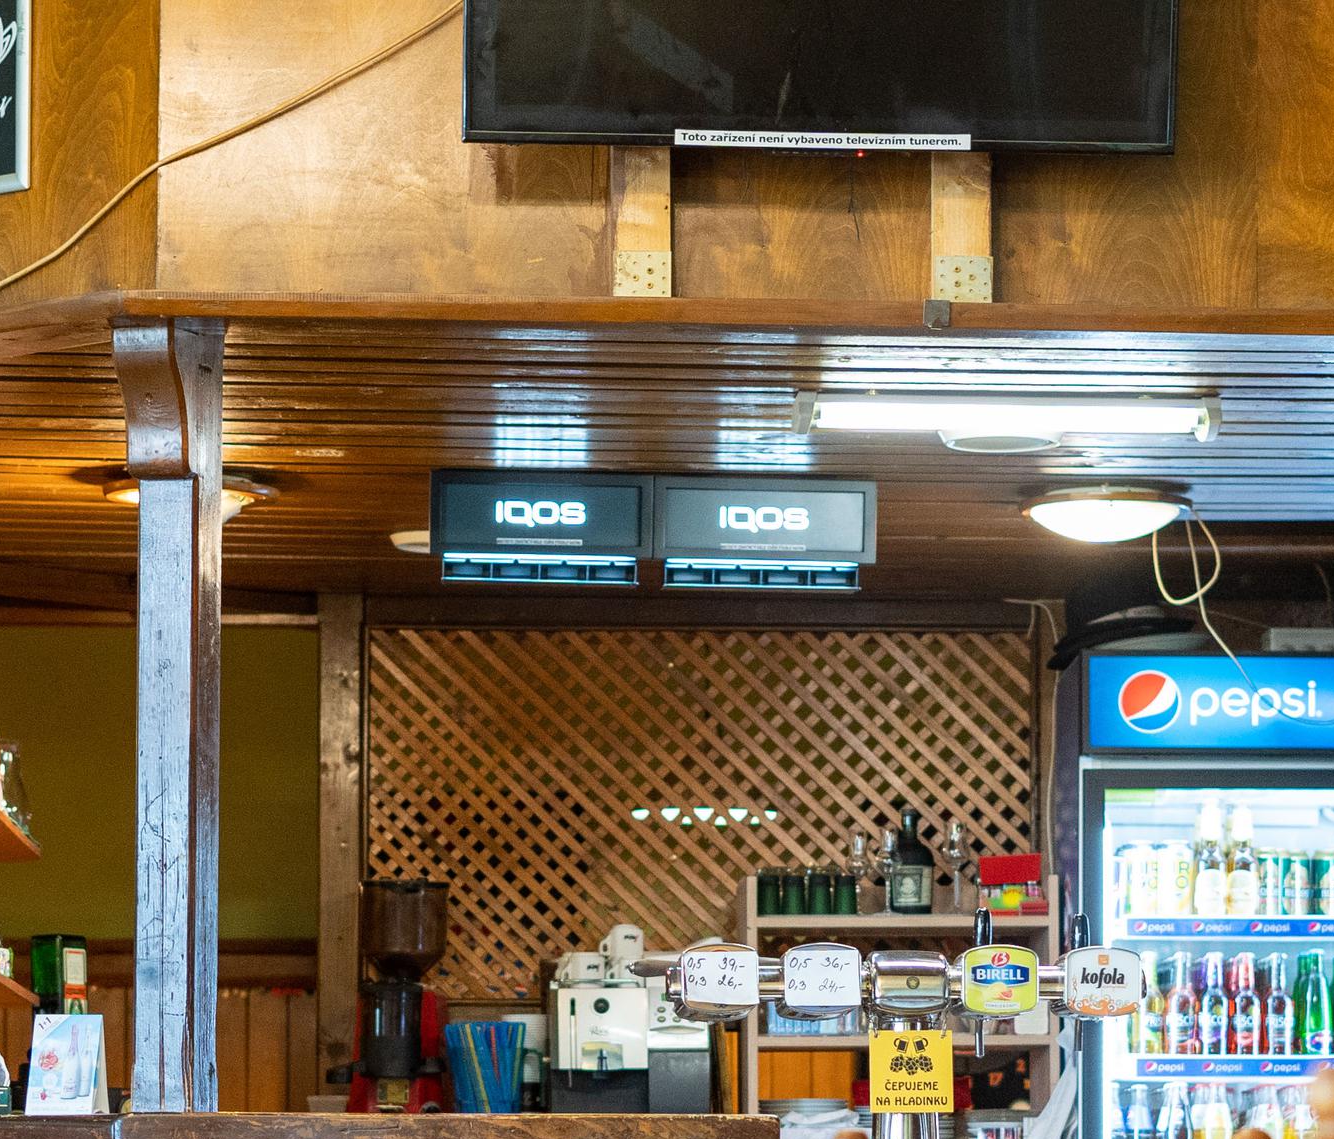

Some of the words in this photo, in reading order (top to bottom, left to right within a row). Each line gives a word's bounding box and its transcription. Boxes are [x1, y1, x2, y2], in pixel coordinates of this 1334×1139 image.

[681, 132, 707, 142] Toto
[710, 133, 756, 143] zařízení
[759, 133, 784, 143] není
[787, 135, 843, 146] vybaveno
[846, 136, 906, 146] televizním
[910, 137, 962, 146] tunerem.
[495, 500, 587, 528] IQOS
[719, 505, 810, 533] IQOS
[1190, 680, 1316, 727] pepsi
[1147, 922, 1175, 933] pepsi
[1263, 923, 1290, 934] pepsi
[687, 957, 706, 969] 0,5
[789, 957, 813, 970] 0,5
[688, 974, 707, 987] 0,3
[976, 968, 1024, 981] BIRELL
[1081, 967, 1125, 988] kofola
[788, 979, 807, 991] 0,3
[1157, 1063, 1185, 1073] pepsi
[1216, 1063, 1243, 1073] pepsi
[1273, 1063, 1300, 1073] pepsi
[884, 1079, 939, 1091] ČEPUJEME
[876, 1096, 891, 1106] NA
[895, 1096, 948, 1106] HLADINKU
